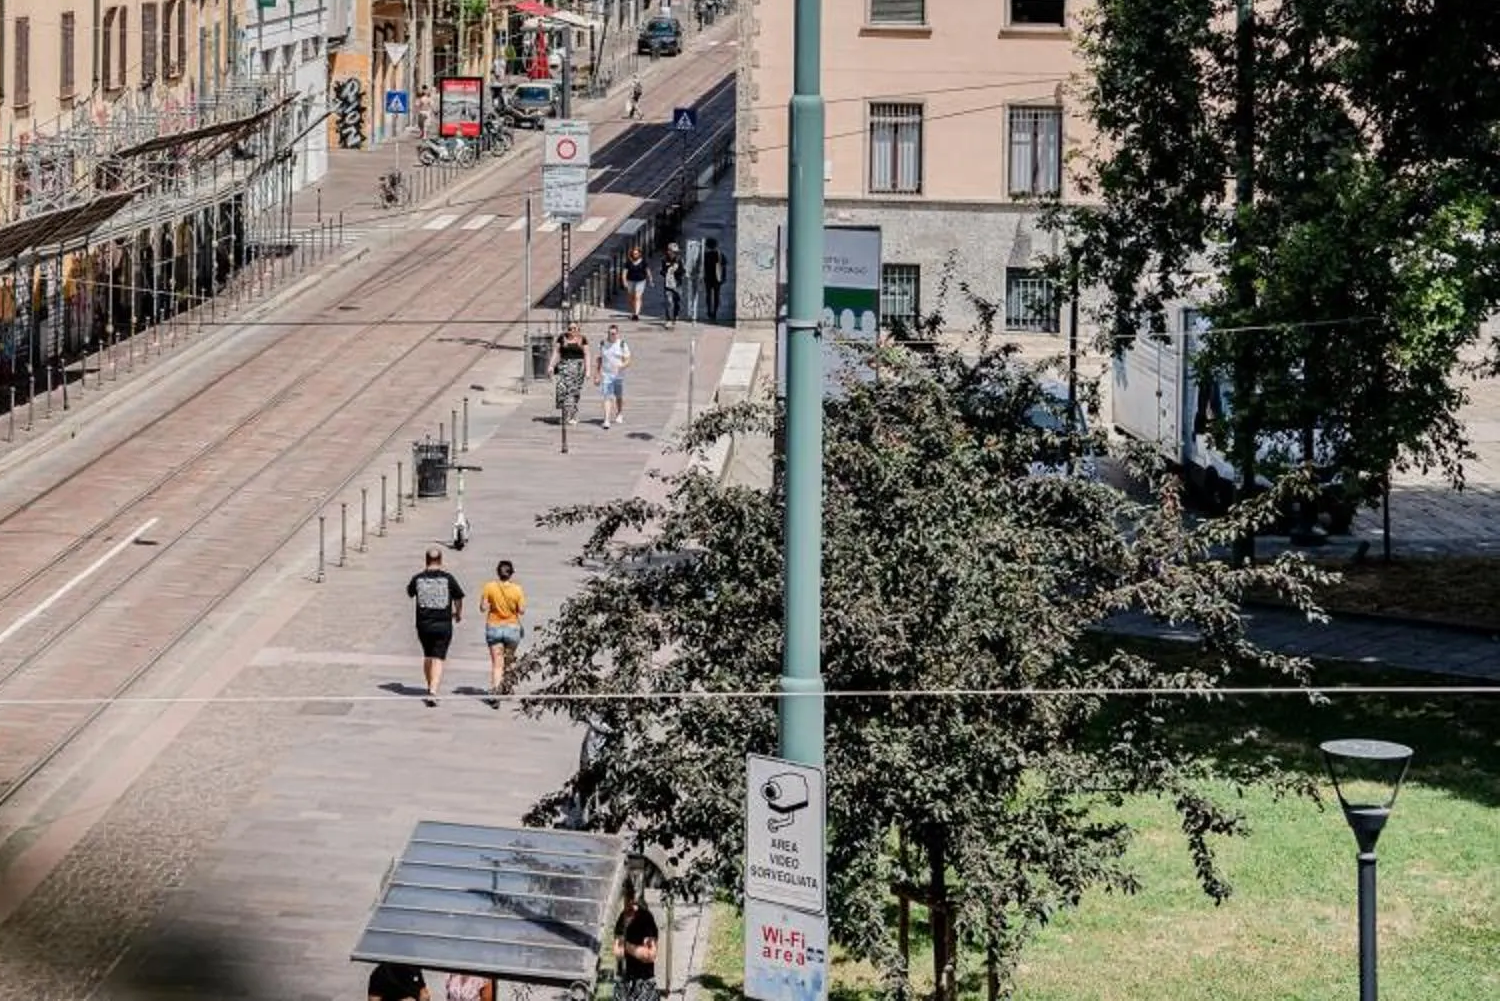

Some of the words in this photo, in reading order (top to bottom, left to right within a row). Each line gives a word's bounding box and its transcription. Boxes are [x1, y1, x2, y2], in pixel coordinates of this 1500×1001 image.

[771, 838, 799, 853] AREA
[769, 852, 800, 870] VIDEO
[750, 864, 818, 889] SORVEGLIATA
[761, 924, 805, 950] Wi-Fi
[762, 945, 805, 966] area
